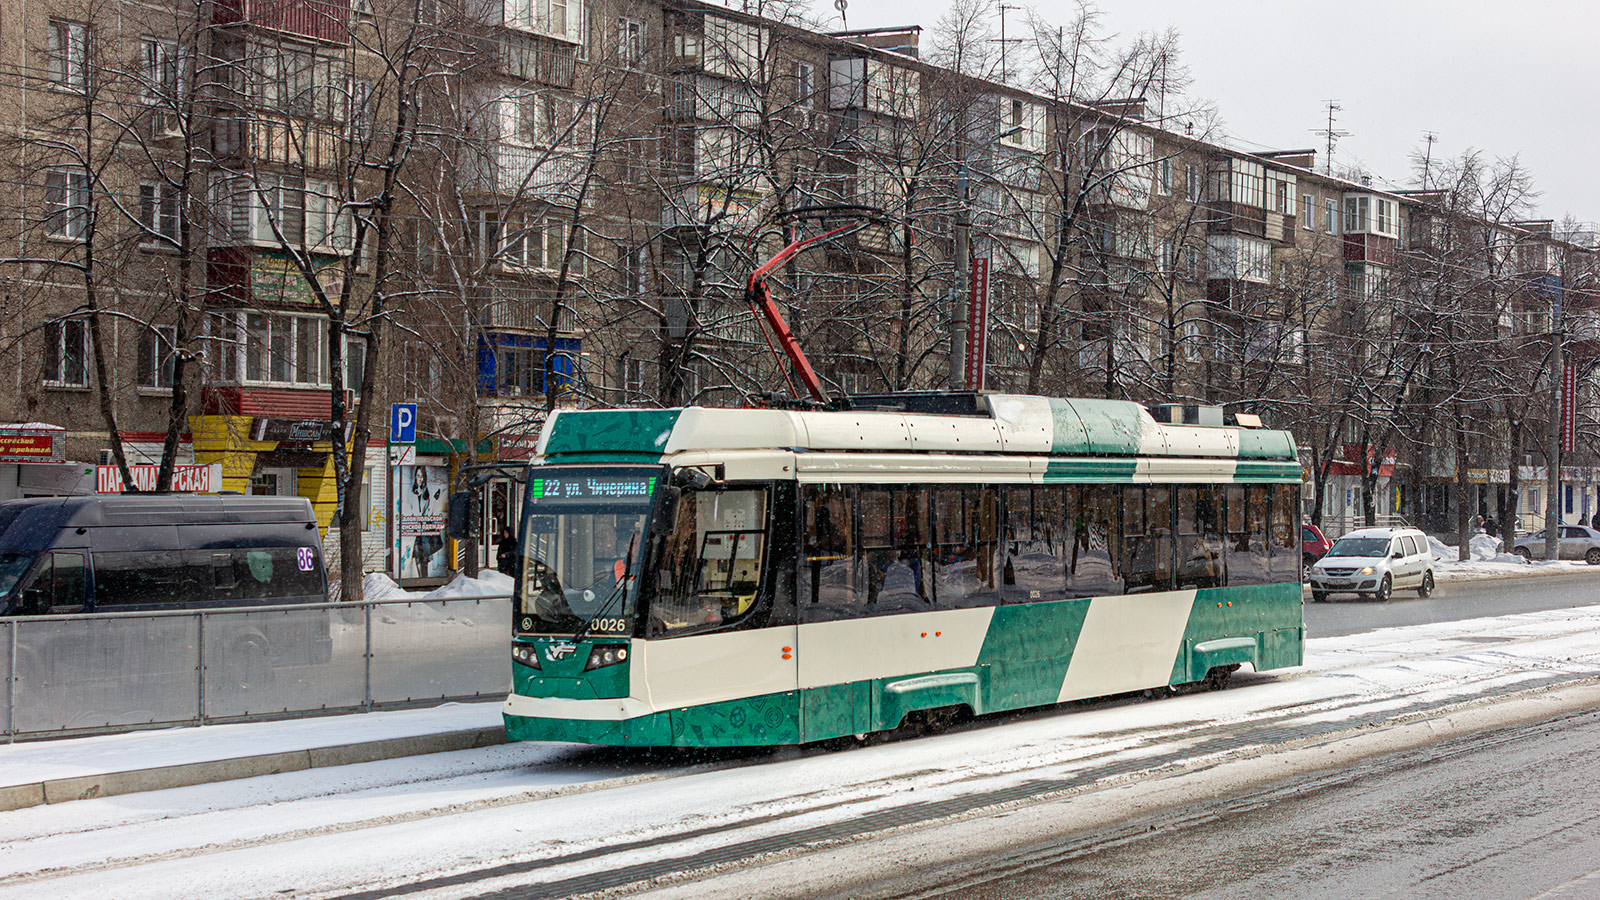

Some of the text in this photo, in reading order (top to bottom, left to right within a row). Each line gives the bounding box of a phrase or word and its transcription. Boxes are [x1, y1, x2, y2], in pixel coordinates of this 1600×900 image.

[398, 407, 412, 438] P
[98, 467, 209, 492] ПАРКМАРСКАЯ
[544, 478, 647, 498] 22 ул. Чичерина
[298, 548, 314, 570] 86
[591, 618, 626, 632] 0026
